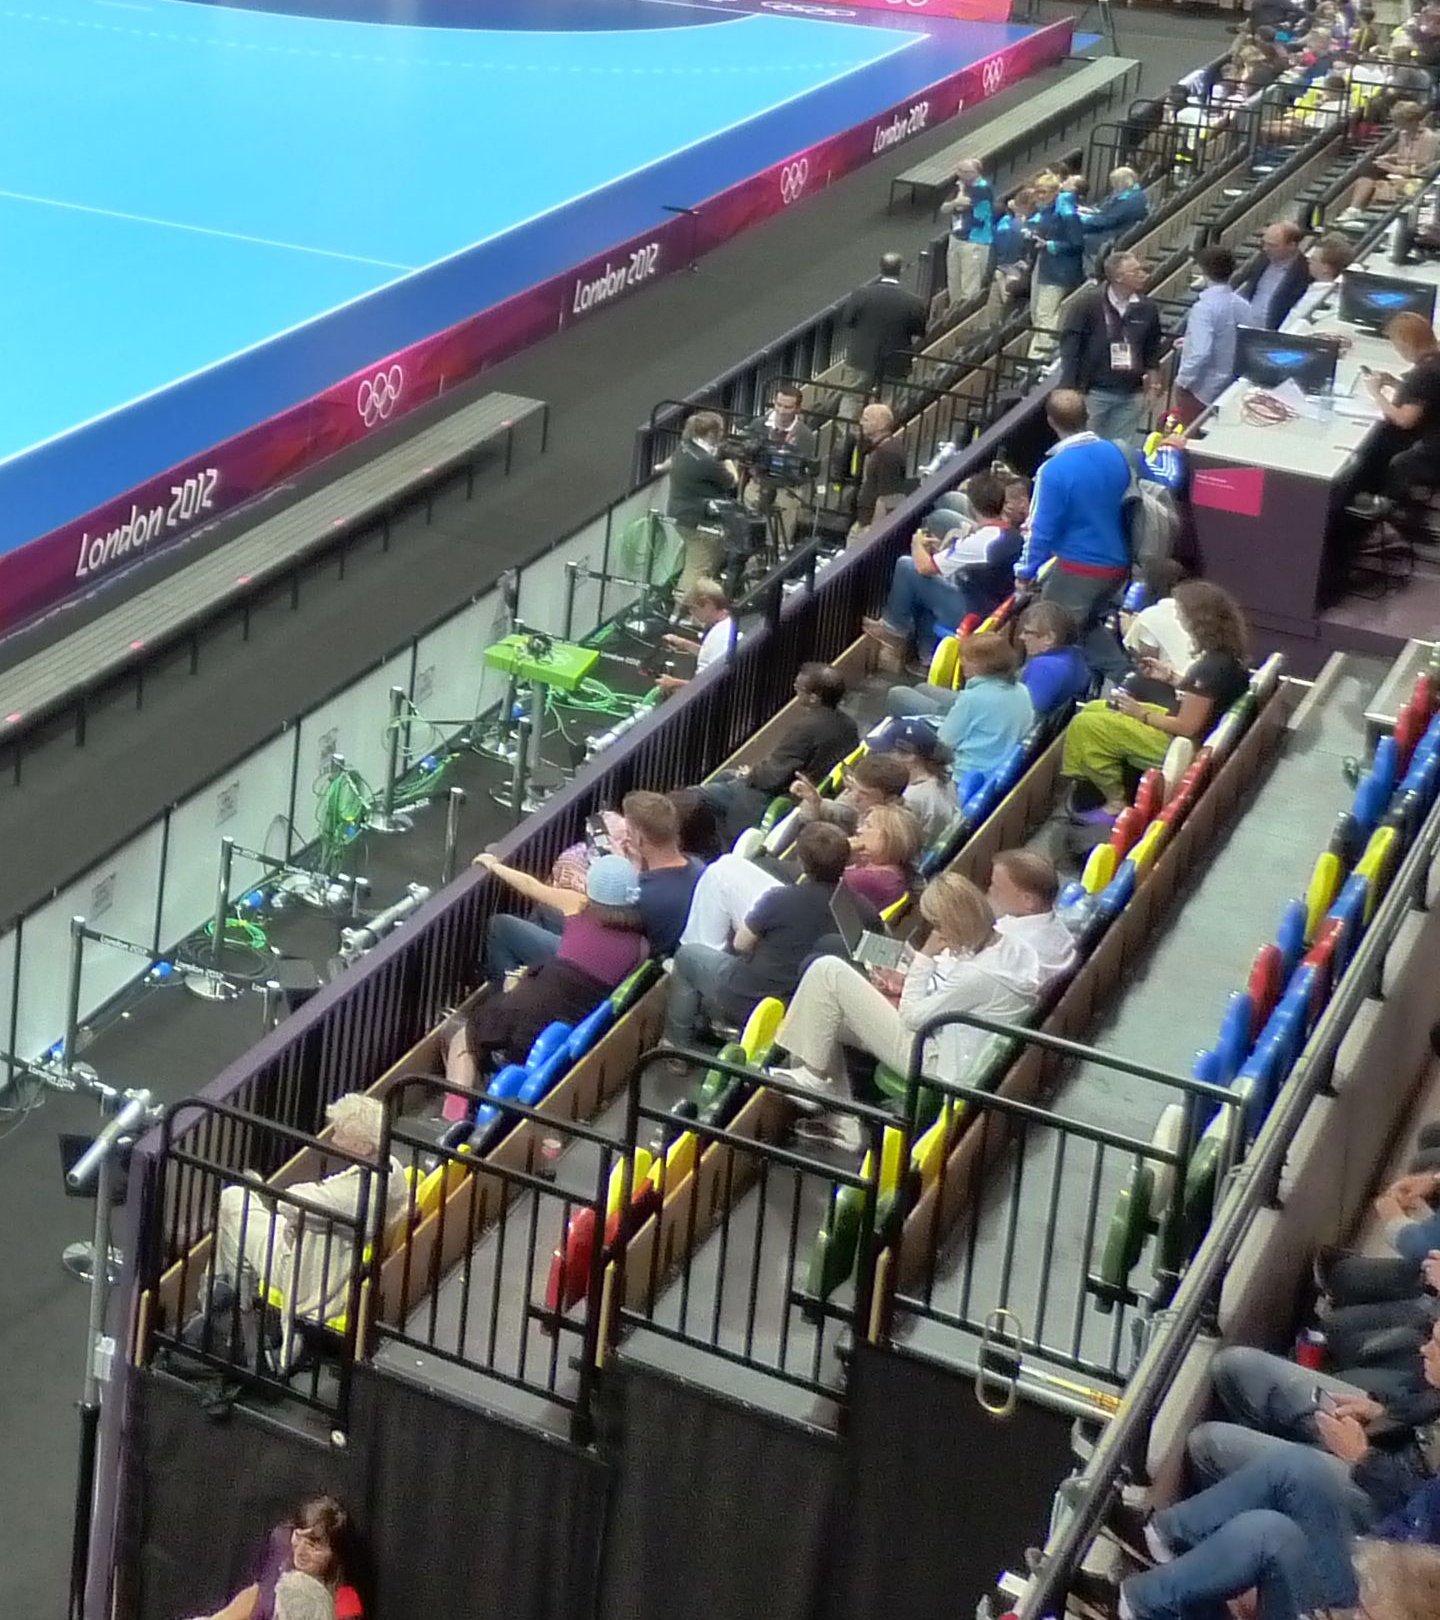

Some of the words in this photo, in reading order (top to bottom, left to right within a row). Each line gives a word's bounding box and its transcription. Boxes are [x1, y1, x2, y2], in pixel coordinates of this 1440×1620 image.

[872, 114, 908, 154] London
[906, 101, 929, 135] 2012
[572, 263, 627, 314] London
[627, 243, 660, 285] 2012
[75, 504, 164, 578] London
[166, 468, 219, 527] 2012
